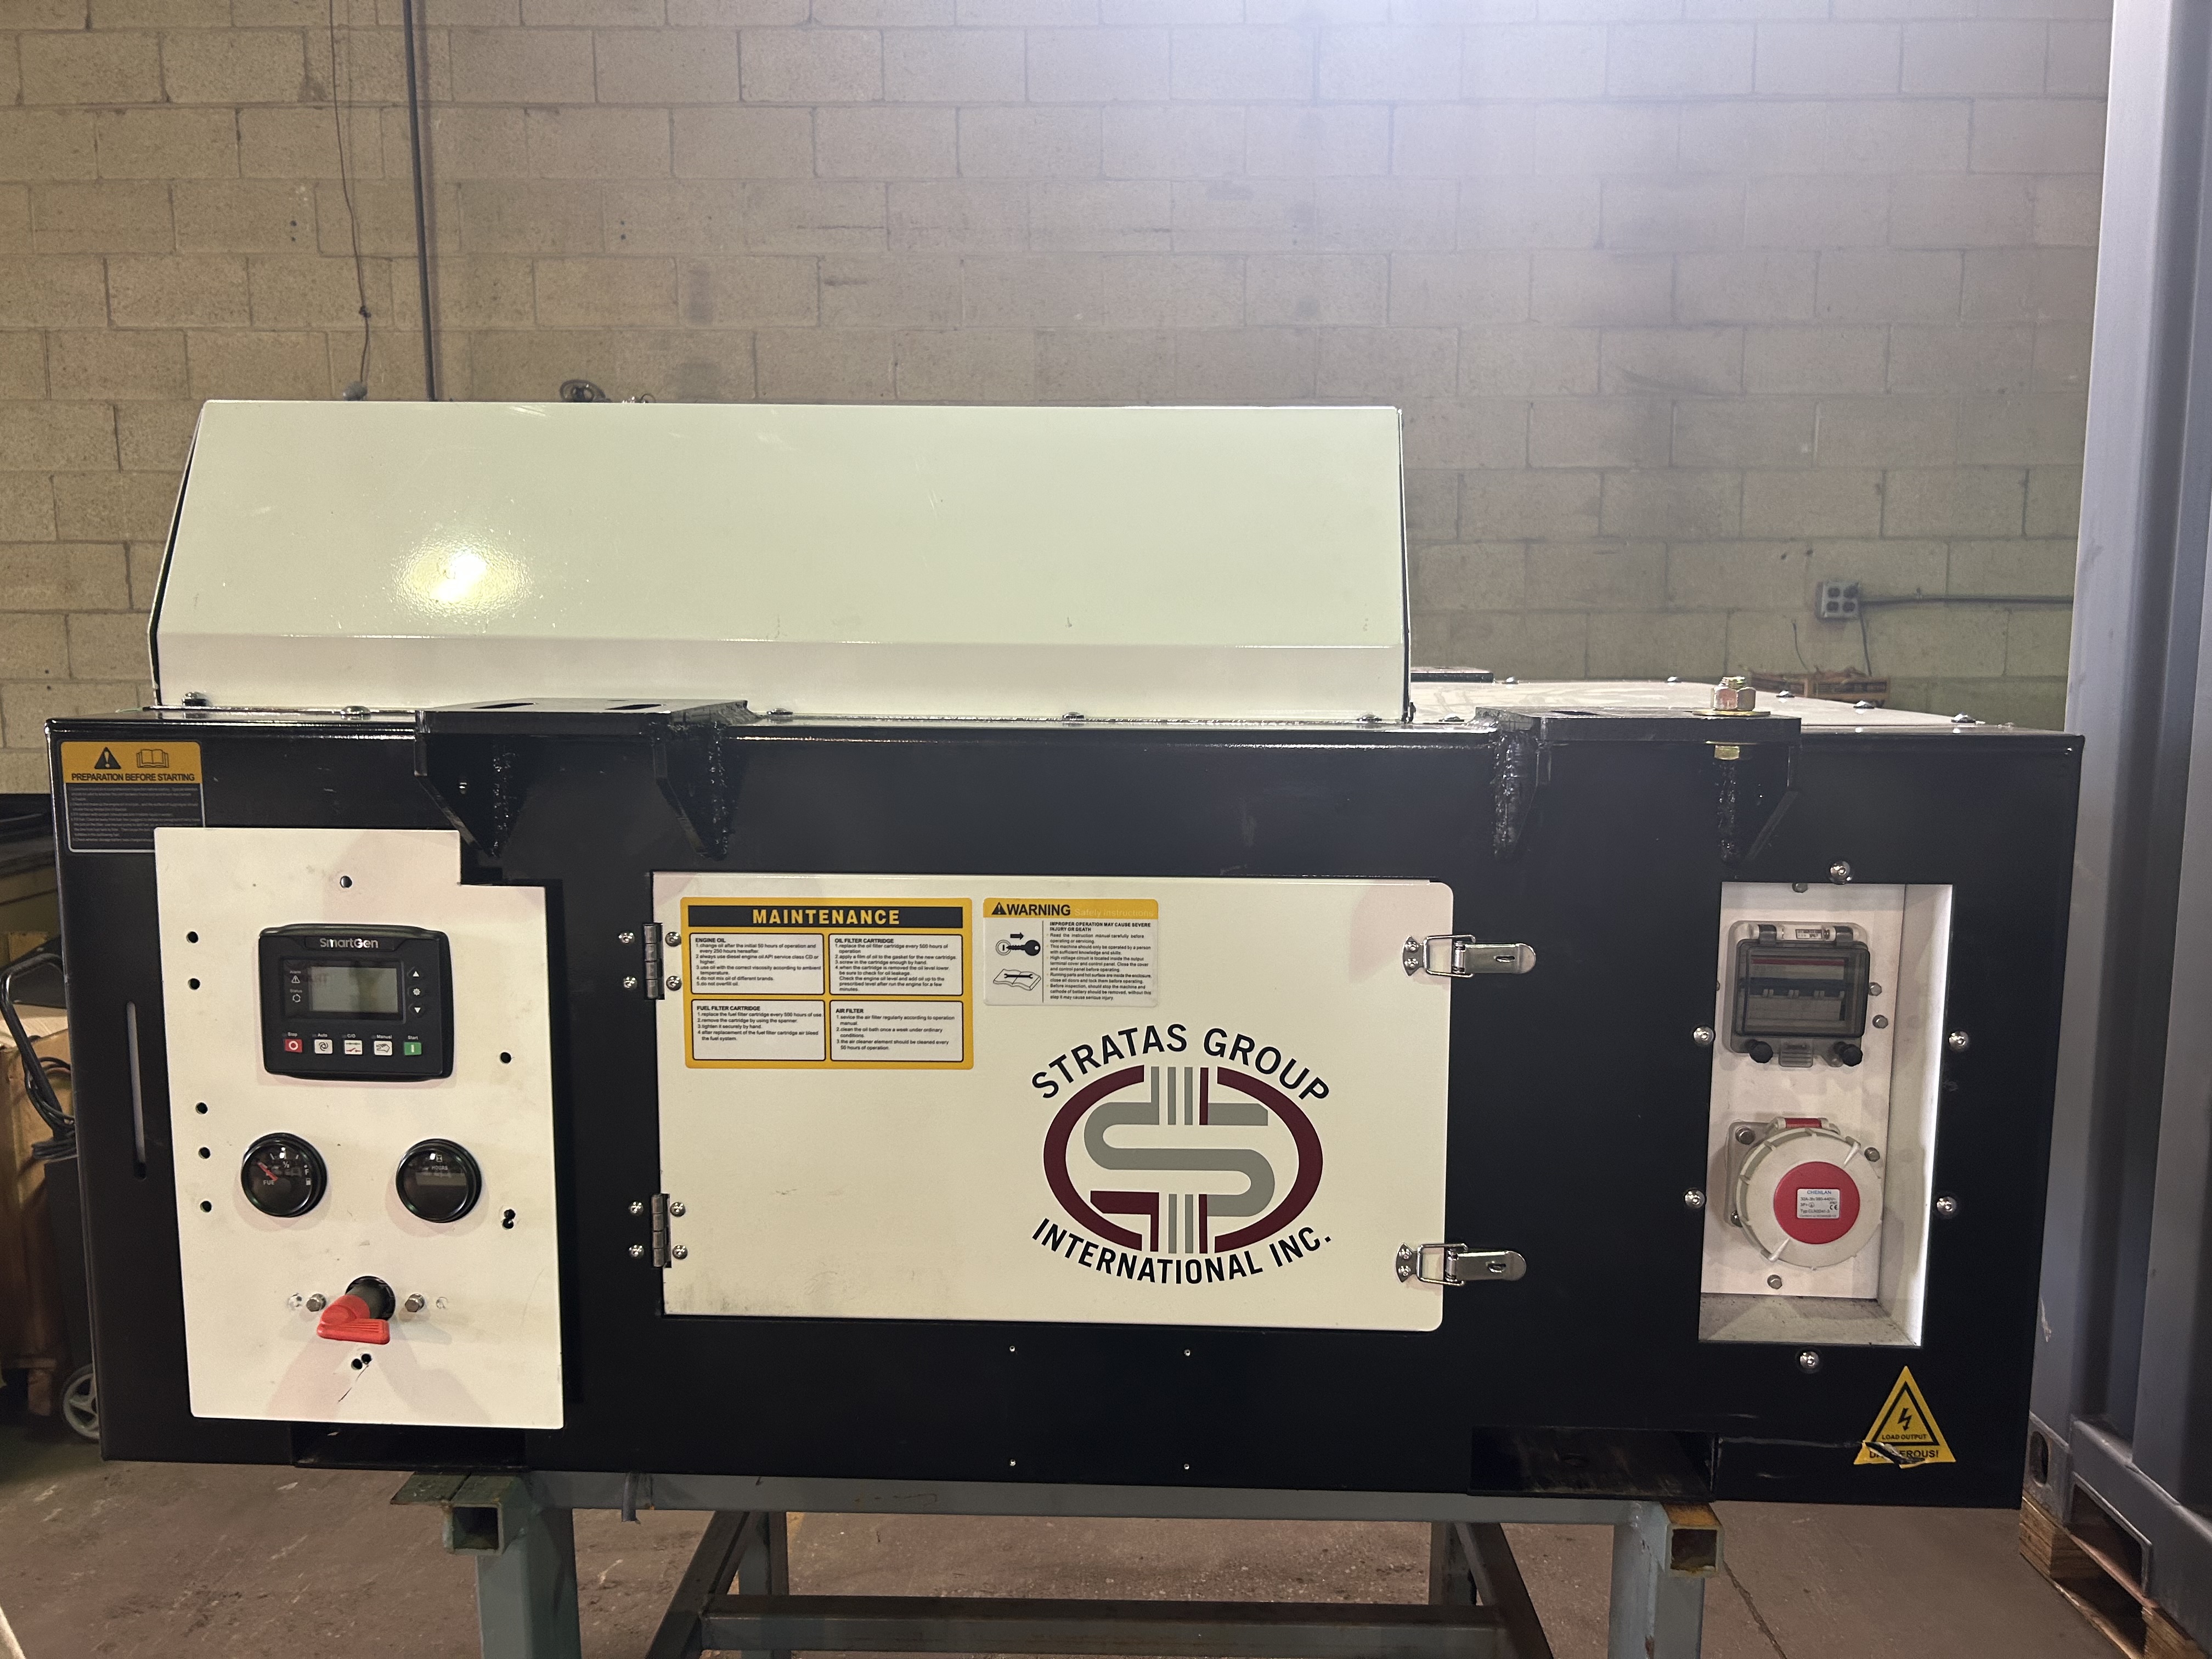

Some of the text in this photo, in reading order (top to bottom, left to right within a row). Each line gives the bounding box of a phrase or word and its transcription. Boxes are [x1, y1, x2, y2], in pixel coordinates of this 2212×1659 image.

[71, 773, 124, 781] PREPARATION
[126, 773, 156, 781] BEFORE
[1007, 904, 1071, 916] WARNING
[752, 909, 900, 925] MAINTENANCE
[319, 938, 379, 949] SmartGen
[1031, 1023, 1329, 1101] STRATAS GROUP
[1031, 1217, 1332, 1285] INTERNATIONAL INC.
[1869, 1449, 1939, 1458] DEROUS!
